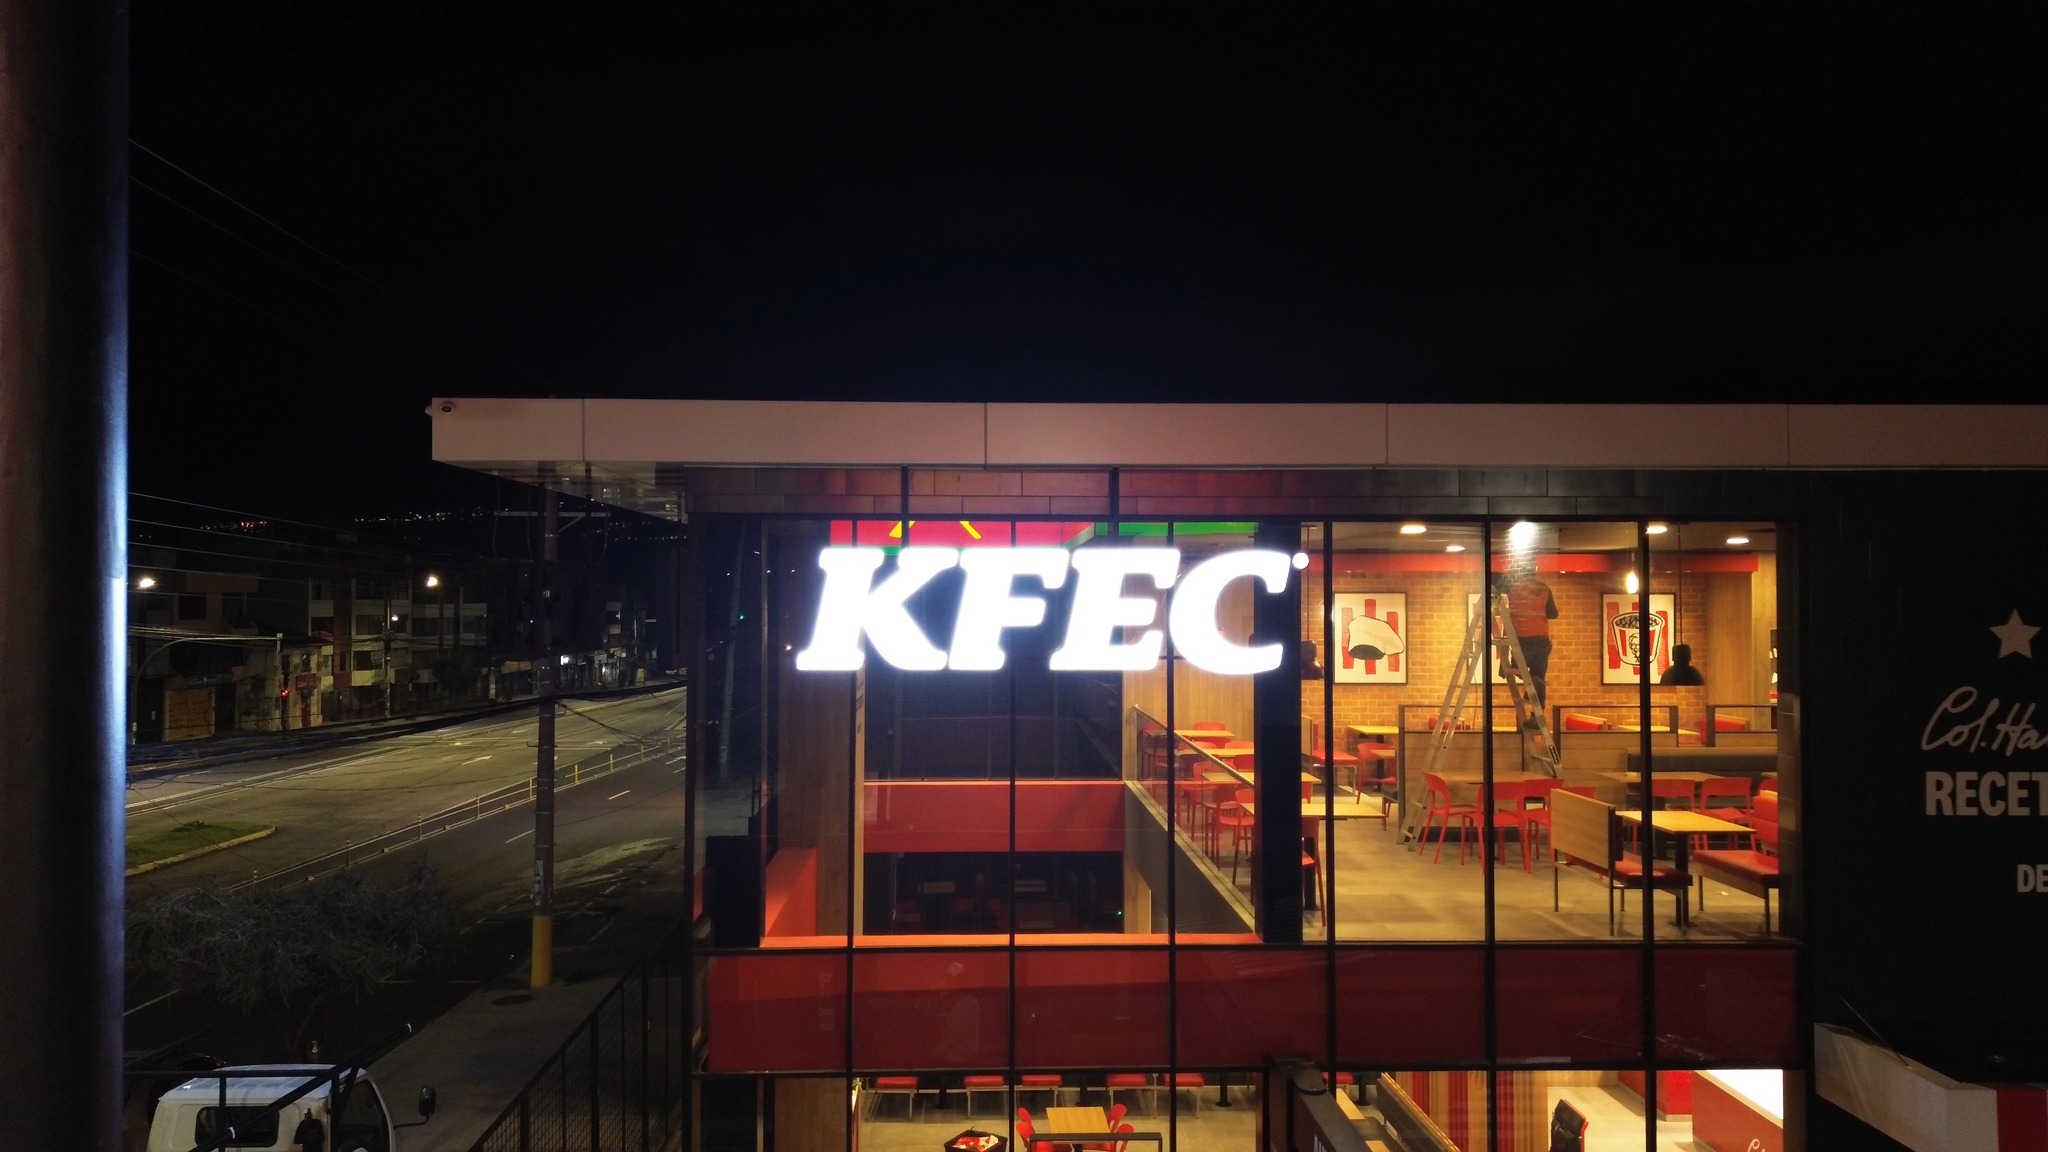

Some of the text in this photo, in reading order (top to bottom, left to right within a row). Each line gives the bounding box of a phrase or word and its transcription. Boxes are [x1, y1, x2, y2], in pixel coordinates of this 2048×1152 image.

[795, 547, 1291, 675] KFEC
[1925, 771, 2048, 816] RECET
[2017, 864, 2048, 892] DE
